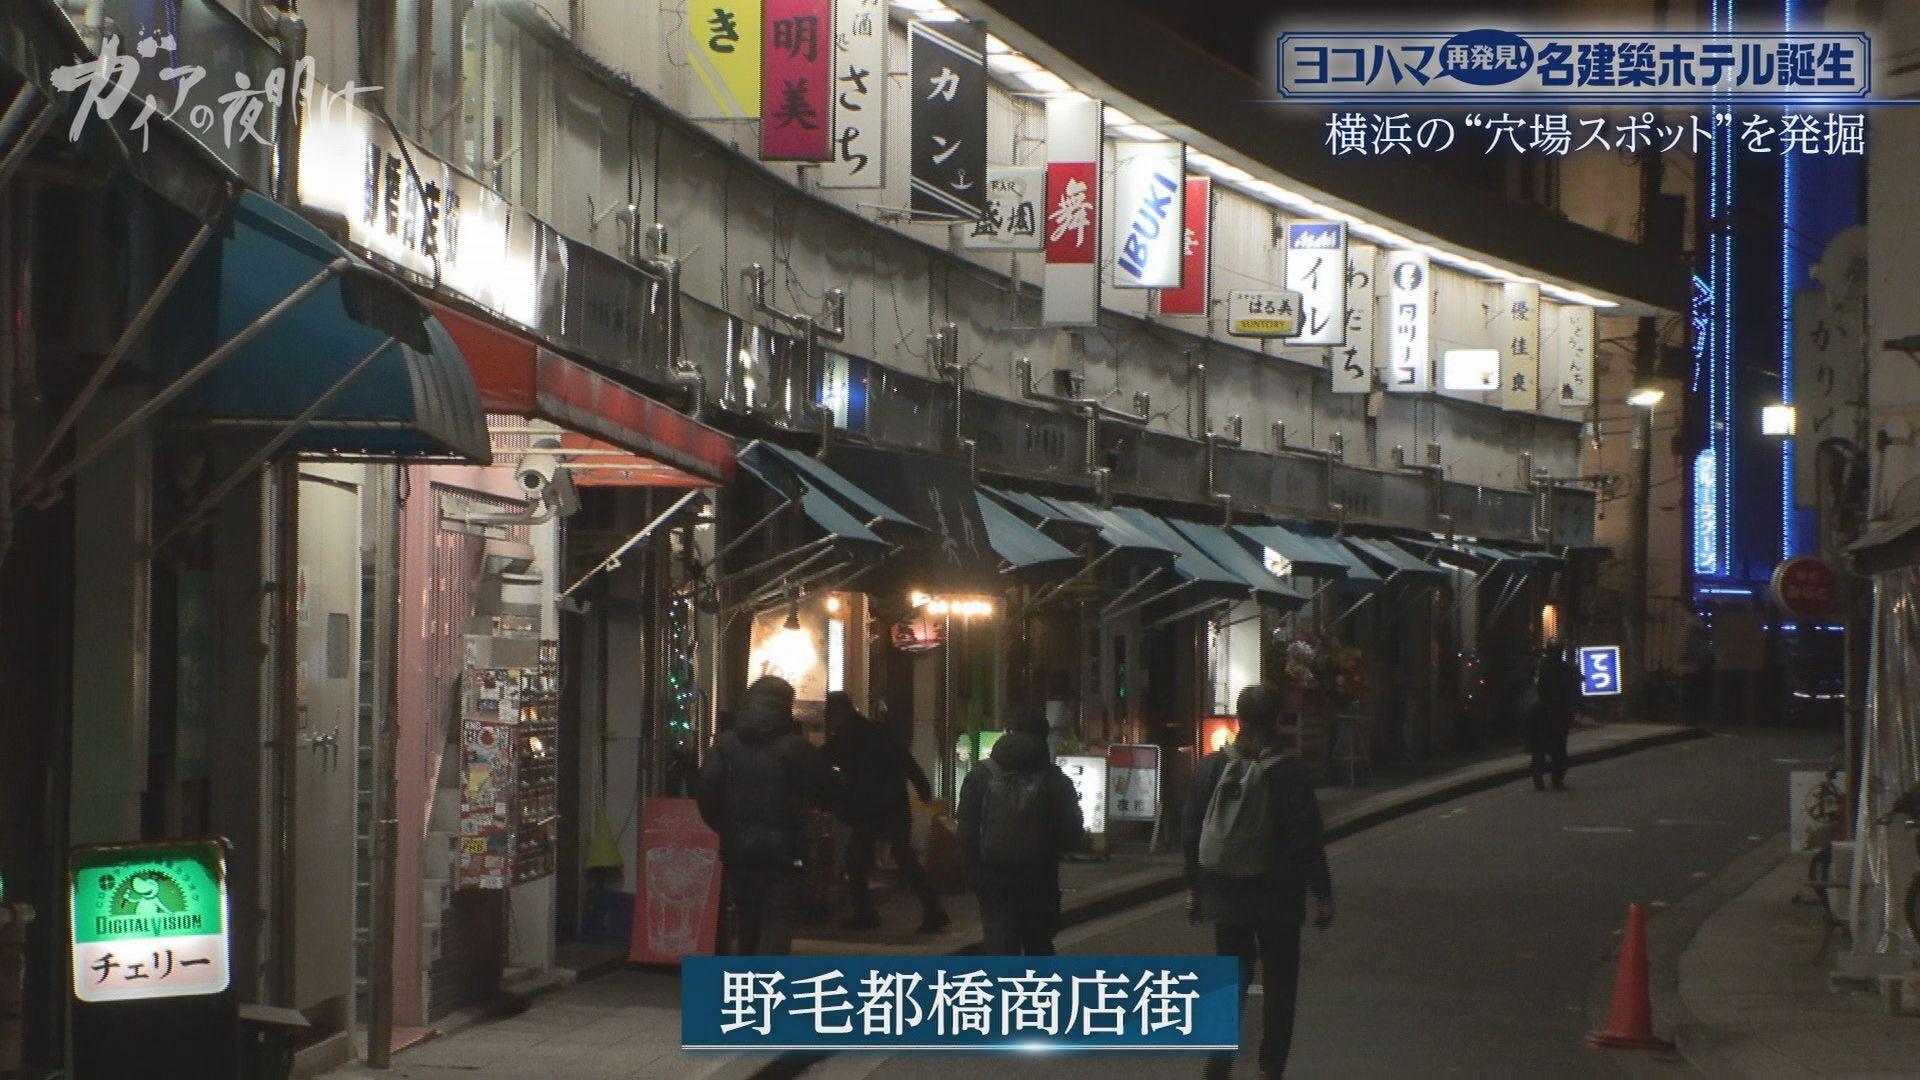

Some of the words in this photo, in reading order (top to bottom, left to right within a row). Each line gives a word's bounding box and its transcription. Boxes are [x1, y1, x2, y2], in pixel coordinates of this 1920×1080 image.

[707, 8, 740, 53] き
[771, 14, 820, 131] 明美
[837, 64, 870, 176] さち
[926, 66, 962, 166] カン
[990, 180, 1016, 193] BAR
[1047, 178, 1094, 248] 舞
[1117, 172, 1178, 279] IBUKI
[1240, 320, 1285, 329] SUNTORY
[1249, 298, 1293, 317] はる美
[1344, 259, 1370, 380] わだち
[1590, 652, 1612, 689] てつ
[91, 949, 212, 985] チェリー
